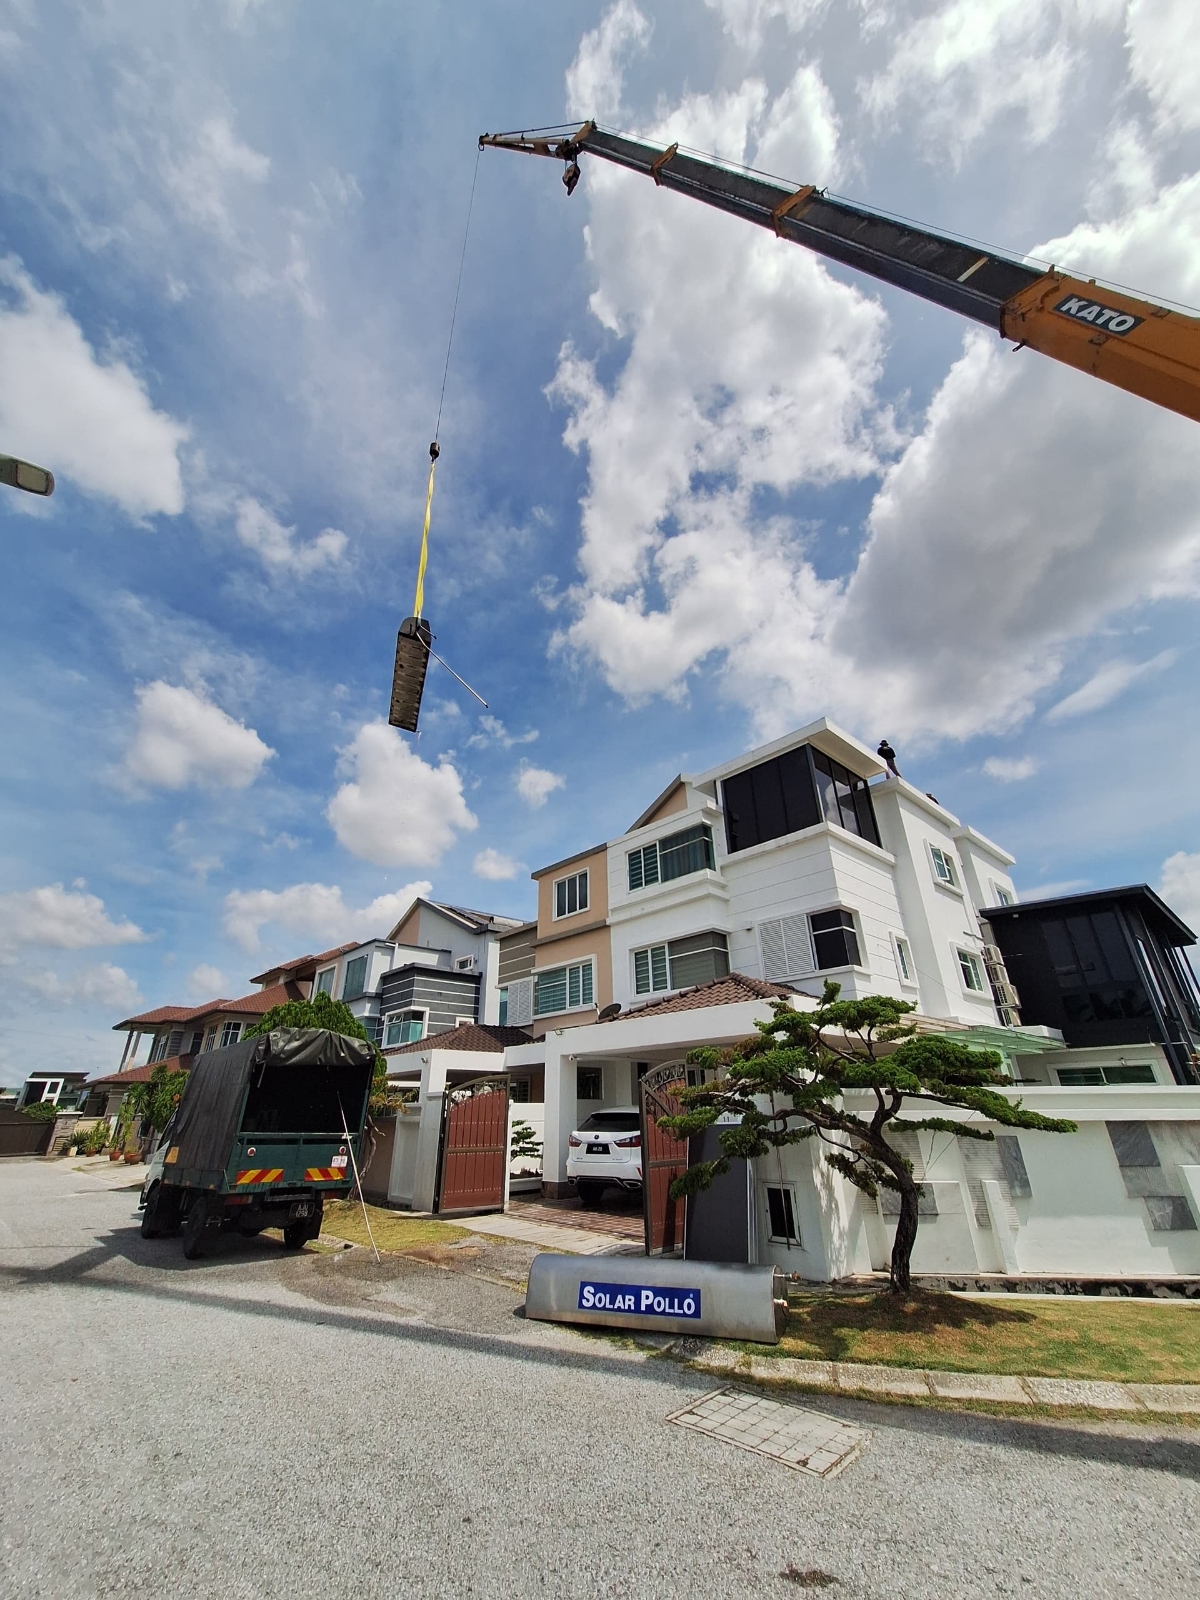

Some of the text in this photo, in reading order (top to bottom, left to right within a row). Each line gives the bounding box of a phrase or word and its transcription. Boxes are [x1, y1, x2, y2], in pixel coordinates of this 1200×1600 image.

[1060, 298, 1135, 332] KATO
[581, 1286, 696, 1315] SOLAR POLLO
